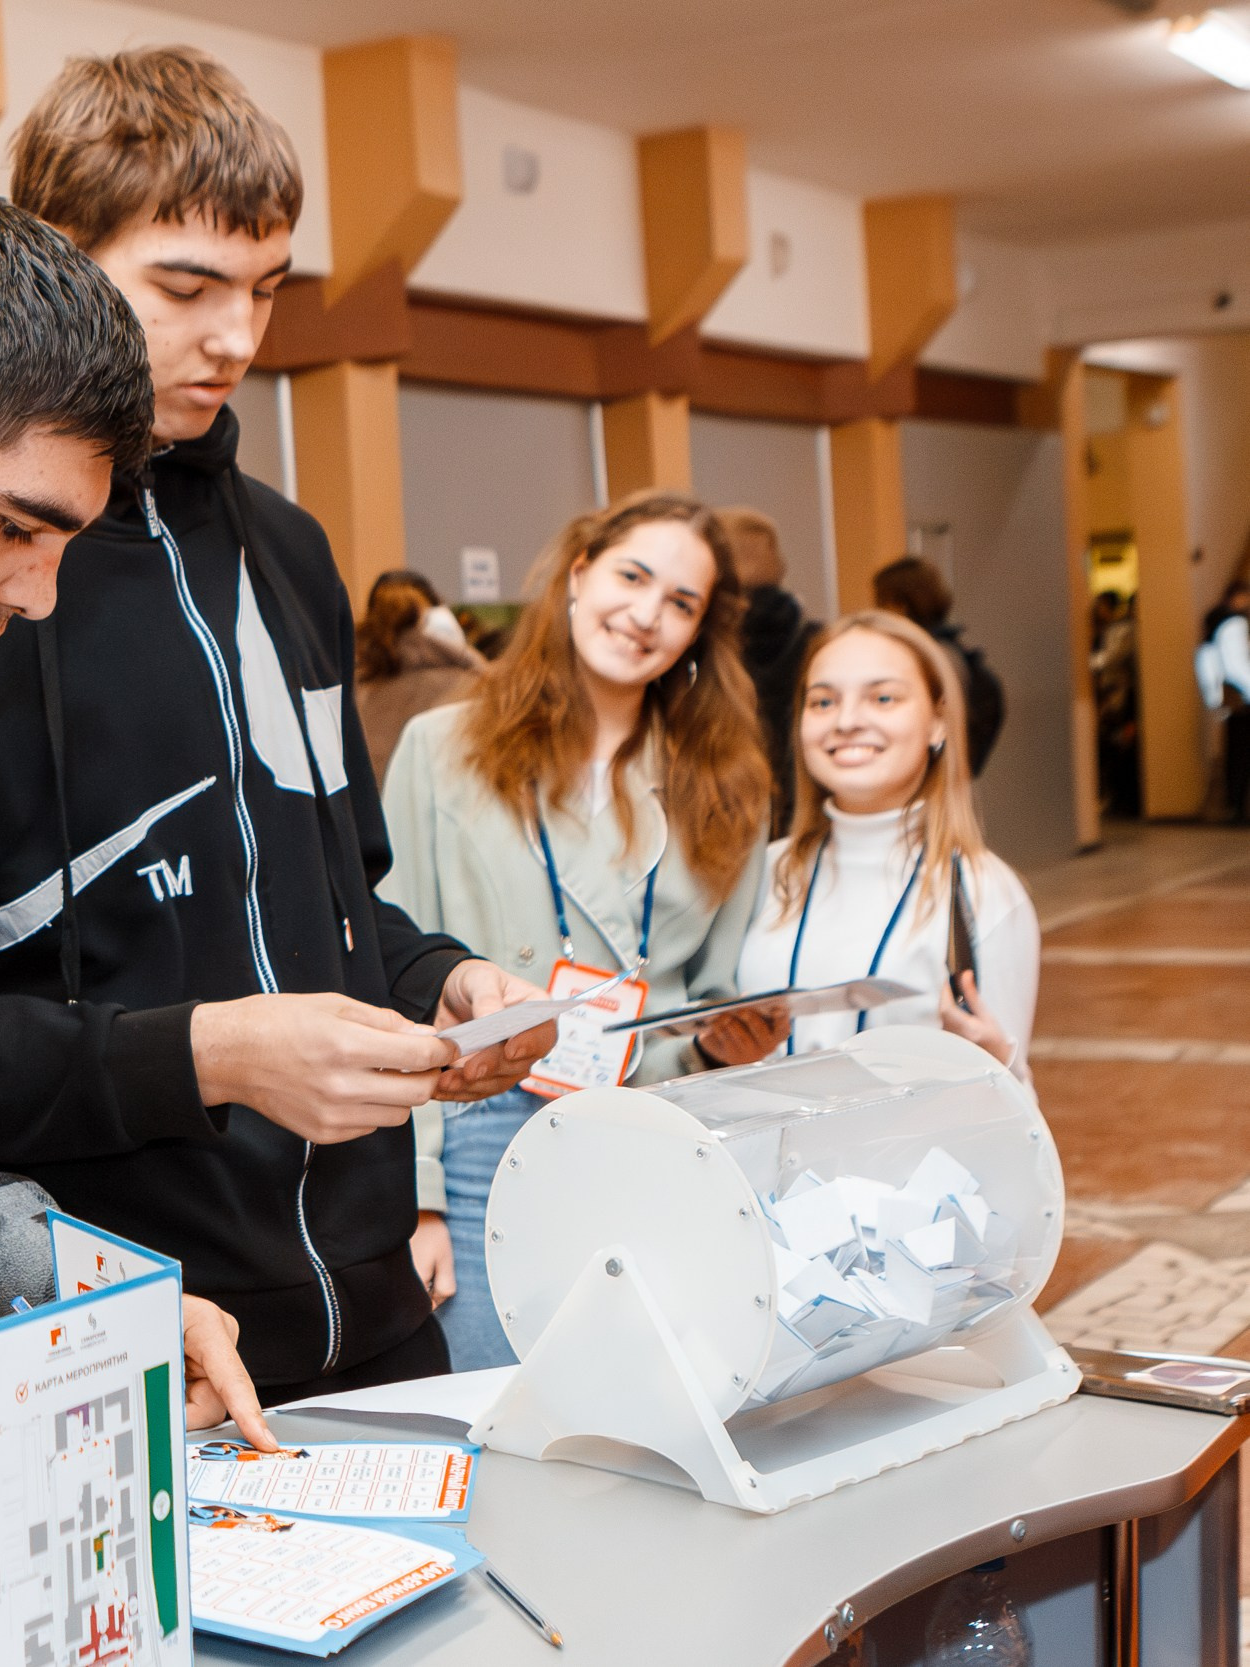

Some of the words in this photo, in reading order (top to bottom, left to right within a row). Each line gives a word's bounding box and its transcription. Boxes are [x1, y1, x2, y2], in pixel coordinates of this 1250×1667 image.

[136, 854, 193, 901] TM
[35, 1376, 64, 1393] КАРТА
[65, 1351, 128, 1381] МЕРОПРИЯТИЯ
